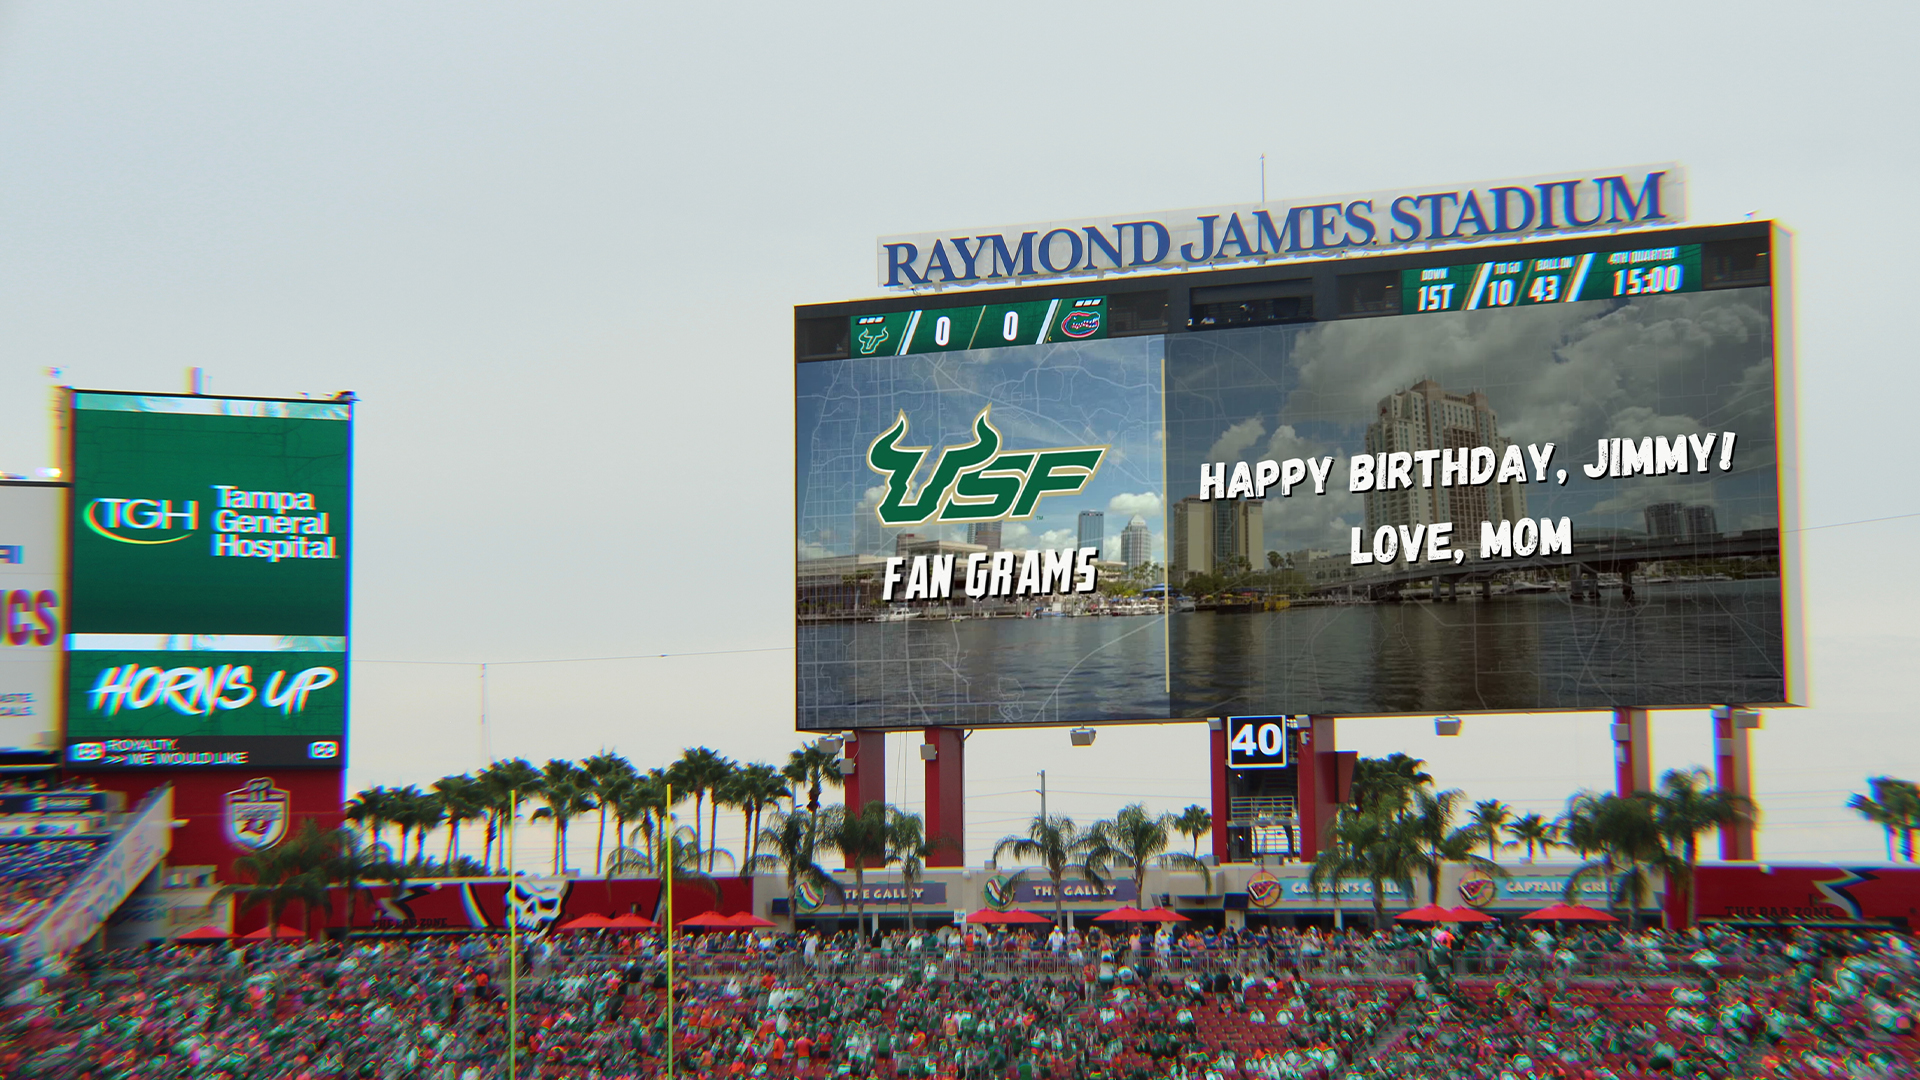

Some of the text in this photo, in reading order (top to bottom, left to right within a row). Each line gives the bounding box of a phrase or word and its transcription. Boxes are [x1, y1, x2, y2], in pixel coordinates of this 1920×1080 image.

[883, 171, 1667, 287] RAYMOND JAMES STADIUM
[1494, 261, 1523, 275] TO GO
[1535, 257, 1574, 272] BALL ON
[1608, 247, 1678, 265] 4TH QUARTER
[1421, 268, 1449, 281] DOWN
[1529, 275, 1561, 302] 43
[1614, 264, 1683, 296] 15:00
[1418, 283, 1455, 311] 1ST
[1488, 279, 1515, 306] 10
[935, 316, 950, 346] 0
[1002, 310, 1019, 341] 0
[866, 402, 1111, 528] USF
[1199, 431, 1736, 501] HAPPY BIRTHDAY, JIMMY!
[94, 497, 199, 530] TGH
[210, 484, 316, 514] Tampa
[211, 509, 330, 534] General
[210, 534, 336, 562] Hospital
[1350, 515, 1573, 566] LOVE, MOM
[882, 545, 1099, 600] FAN GRAMS
[0, 589, 60, 646] CS
[86, 663, 338, 717] HORNS UP
[1231, 723, 1283, 757] 40
[126, 752, 155, 765] WE
[155, 752, 213, 765] WOULD
[213, 751, 249, 765] LIKE
[1291, 882, 1401, 895] CATAIN'S GILL
[1725, 906, 1755, 917] THE
[1794, 907, 1834, 917] ZONE
